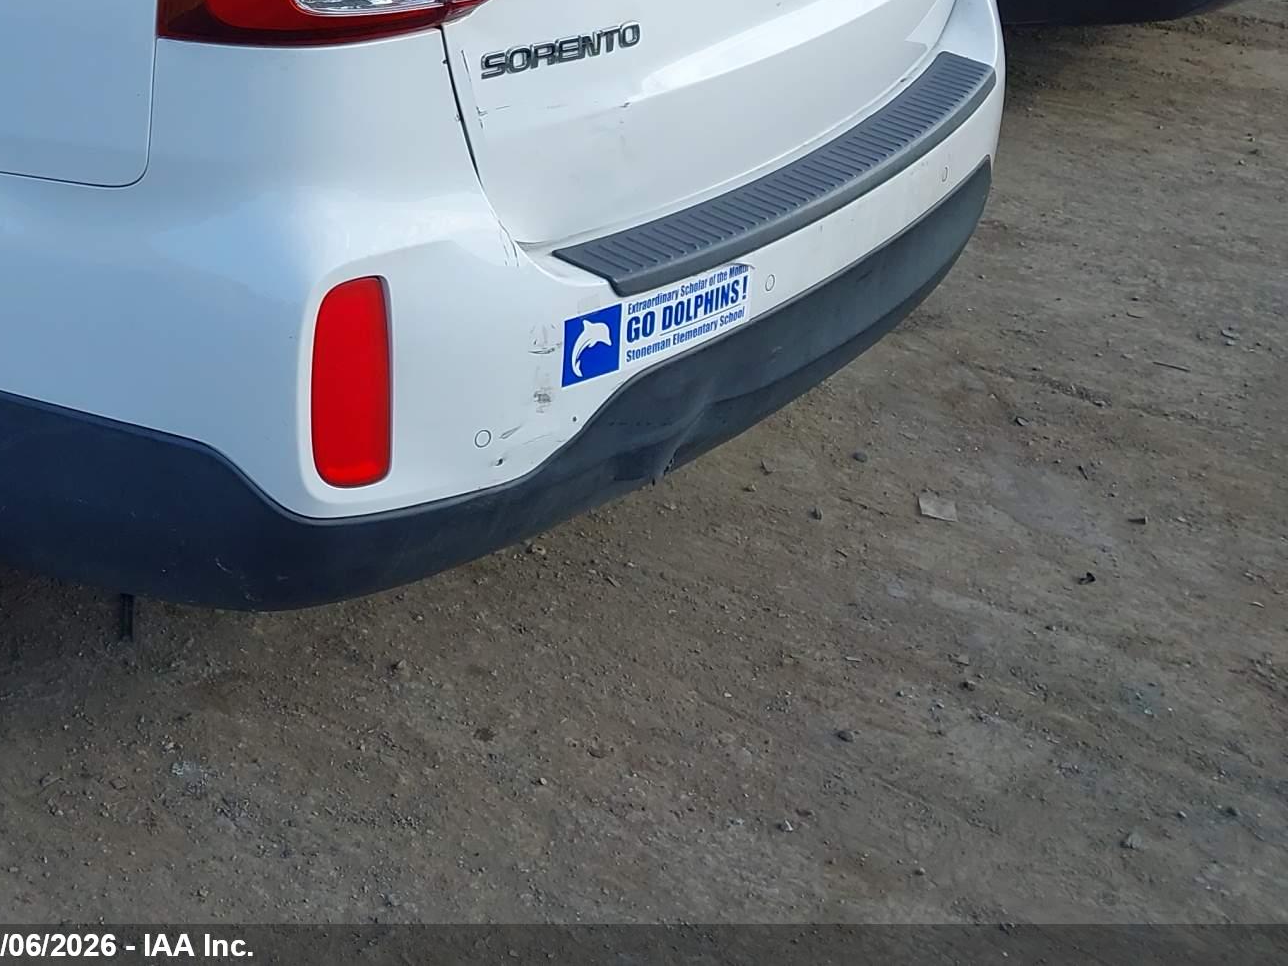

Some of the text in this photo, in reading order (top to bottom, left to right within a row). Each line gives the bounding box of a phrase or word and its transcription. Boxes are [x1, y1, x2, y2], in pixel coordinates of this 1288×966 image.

[481, 19, 641, 80] SORENTO
[626, 275, 748, 344] GO DOLPHINS!
[627, 265, 749, 315] Extraordinary Scholar of the Month
[626, 306, 745, 363] Stoneman Elementary School
